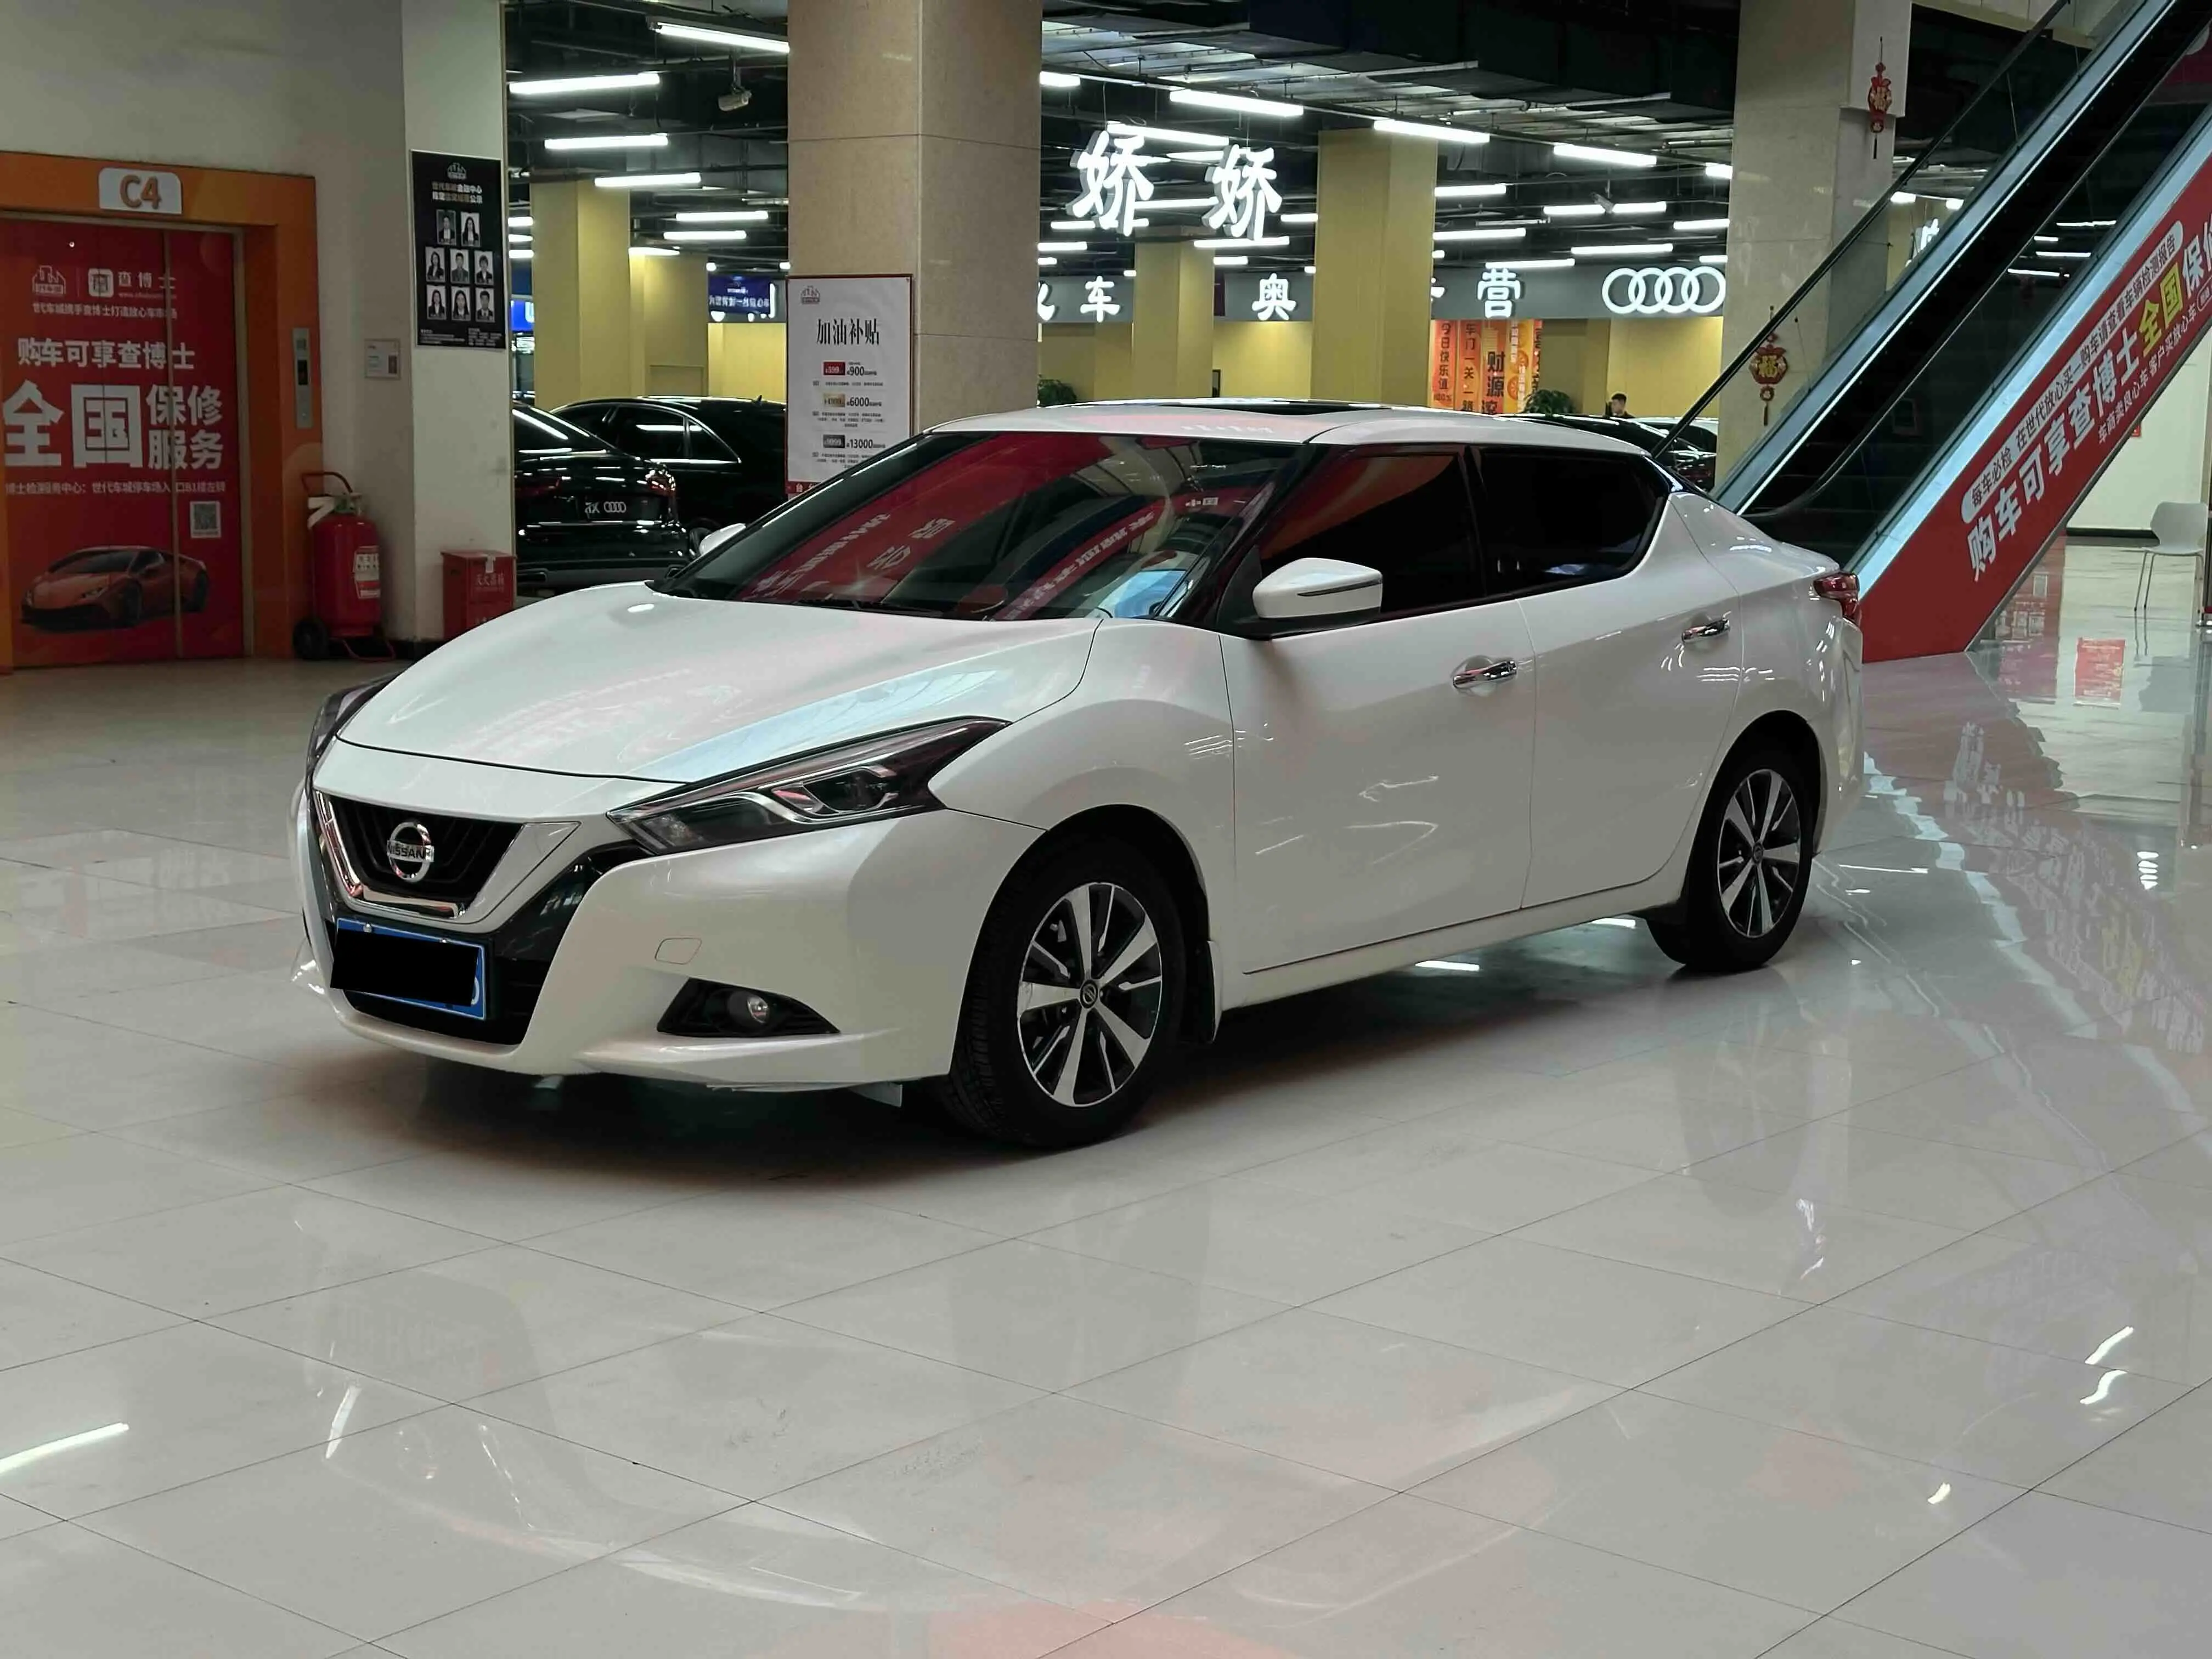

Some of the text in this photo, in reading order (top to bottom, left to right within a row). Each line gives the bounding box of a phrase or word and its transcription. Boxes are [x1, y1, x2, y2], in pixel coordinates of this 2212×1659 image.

[120, 174, 162, 209] C4
[1066, 129, 1283, 240] 娇娇
[1251, 273, 1296, 321] 奥
[816, 318, 880, 346] 加油补贴
[18, 337, 195, 370] 购车可享查博士
[2, 380, 143, 469] 全国
[145, 384, 223, 426] 保修
[148, 429, 224, 471] 服务
[1971, 447, 2013, 506] 每车必检
[387, 841, 427, 860] NISSAN
